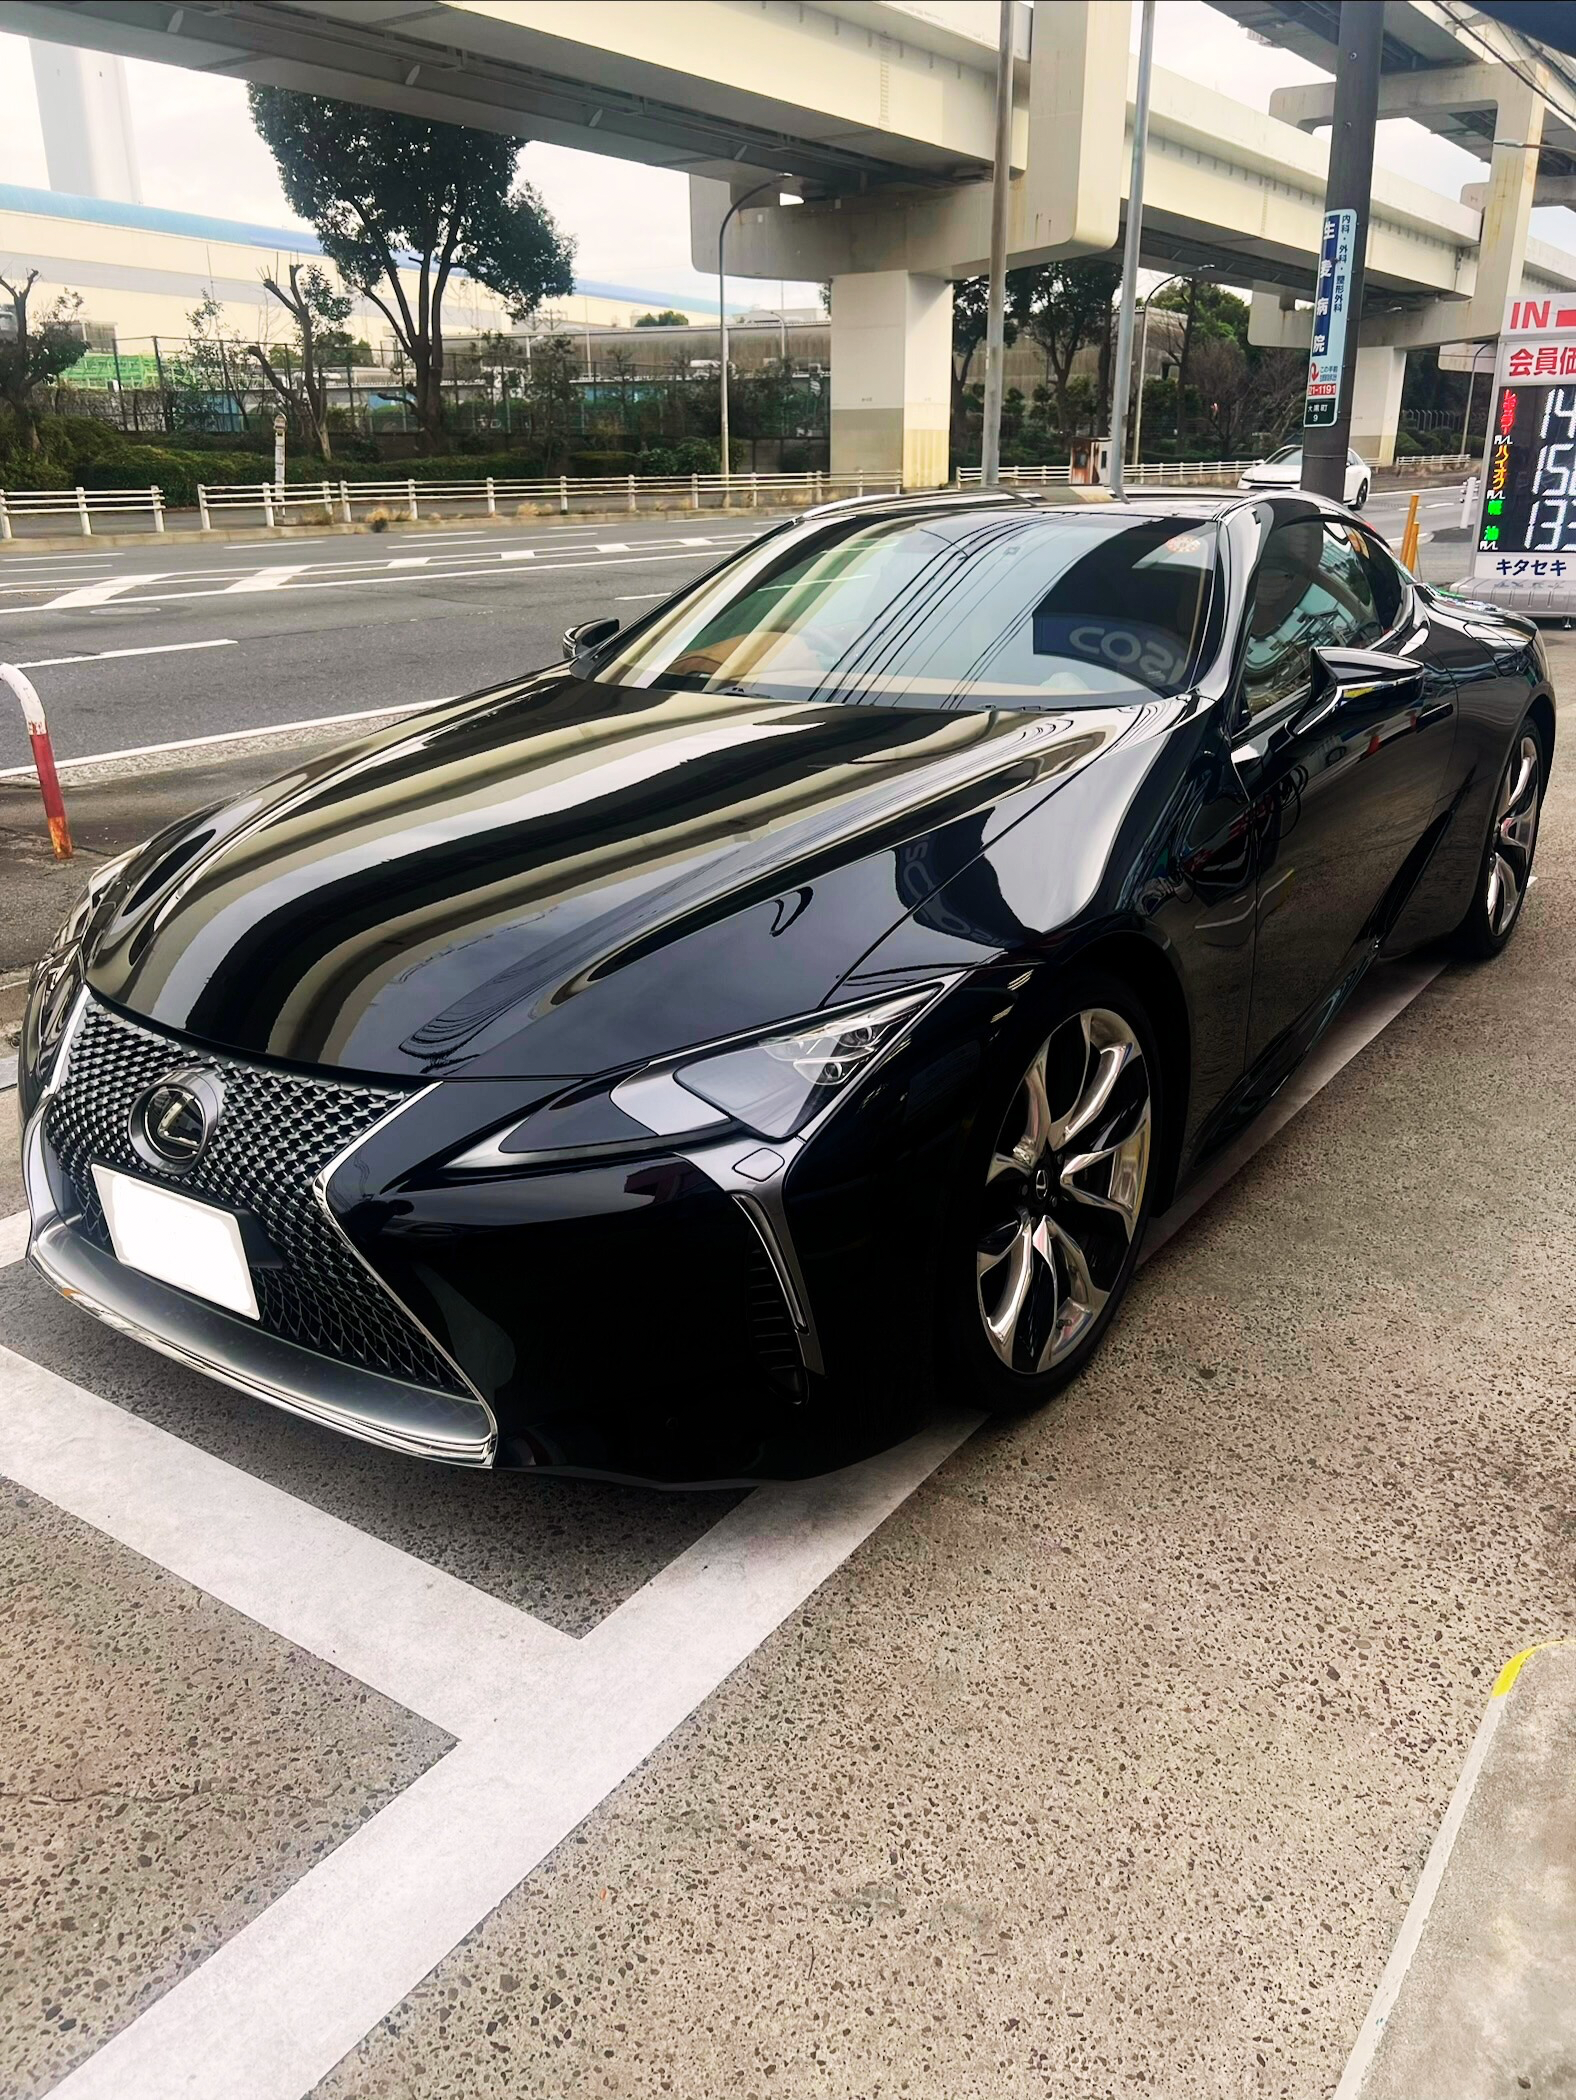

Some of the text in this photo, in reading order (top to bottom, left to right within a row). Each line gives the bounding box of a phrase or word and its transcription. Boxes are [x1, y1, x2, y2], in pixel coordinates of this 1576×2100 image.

[1510, 301, 1551, 330] IN
[1313, 414, 1319, 422] 9
[1493, 444, 1509, 490] ハイオク
[1496, 559, 1567, 577] キタセキ
